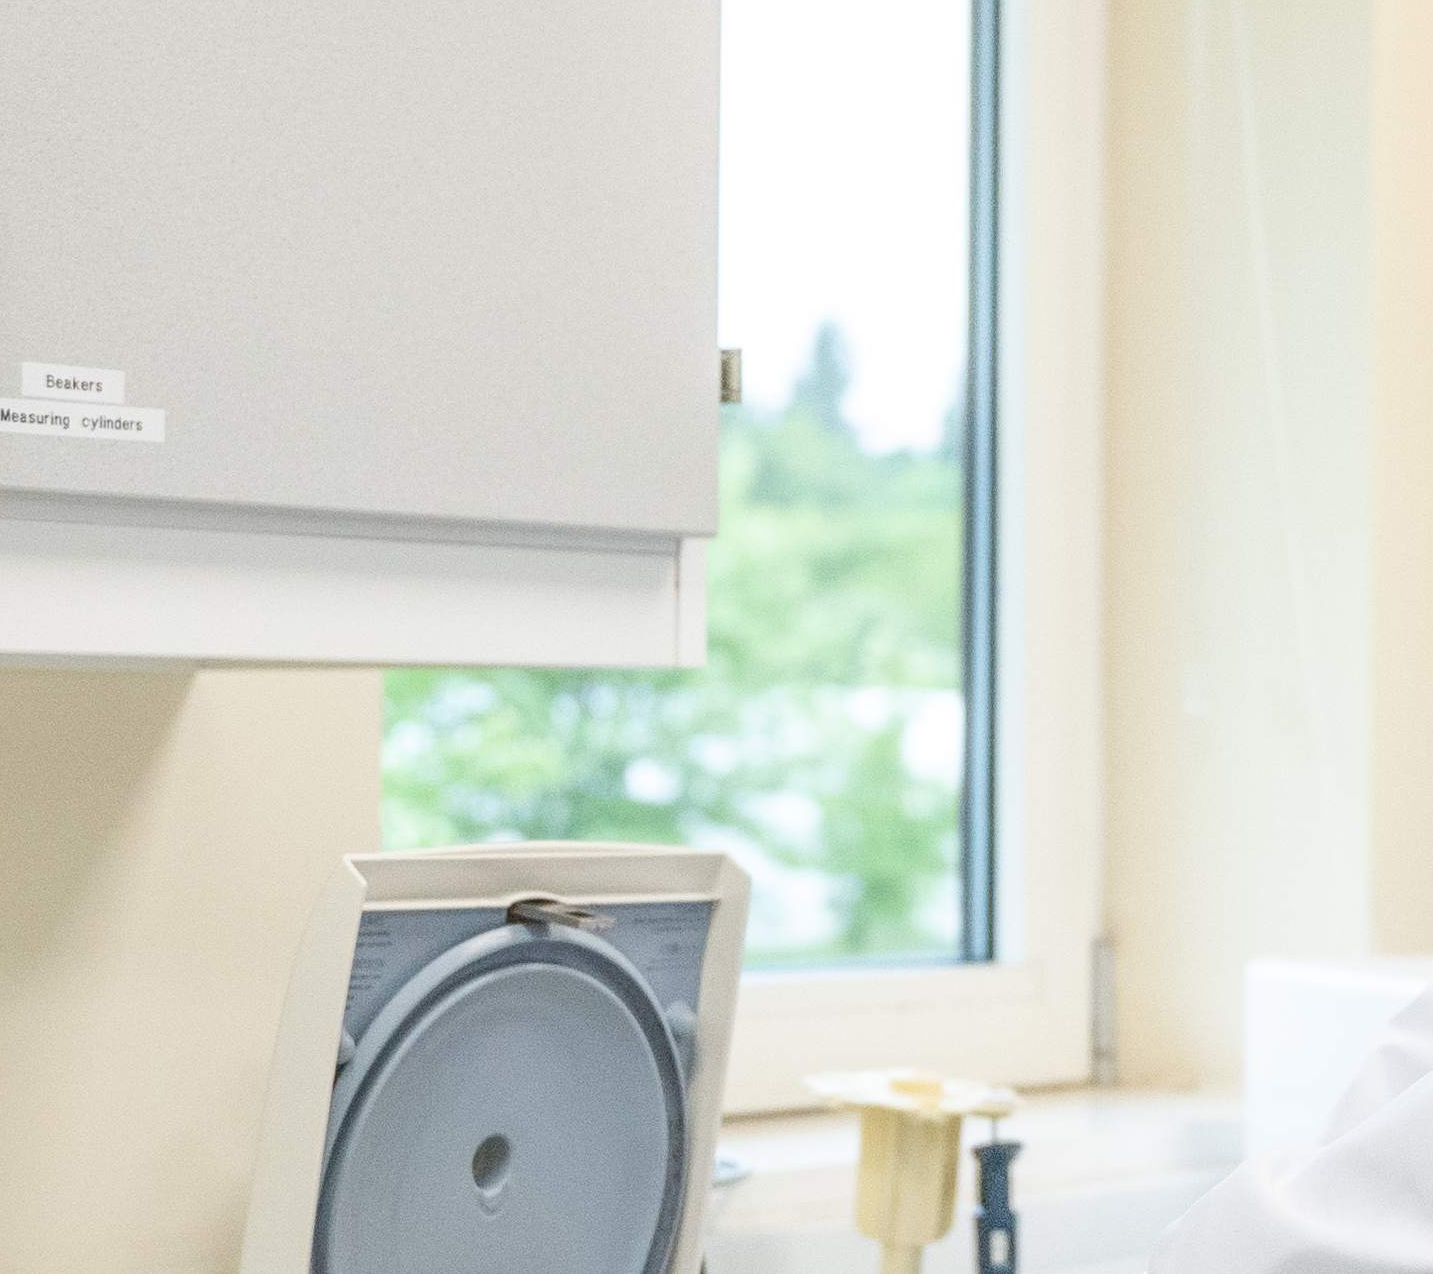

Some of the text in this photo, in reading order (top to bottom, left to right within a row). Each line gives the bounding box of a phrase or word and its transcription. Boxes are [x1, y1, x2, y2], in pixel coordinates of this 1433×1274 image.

[46, 374, 104, 393] Beakers
[0, 408, 144, 432] Measuring cylinders
